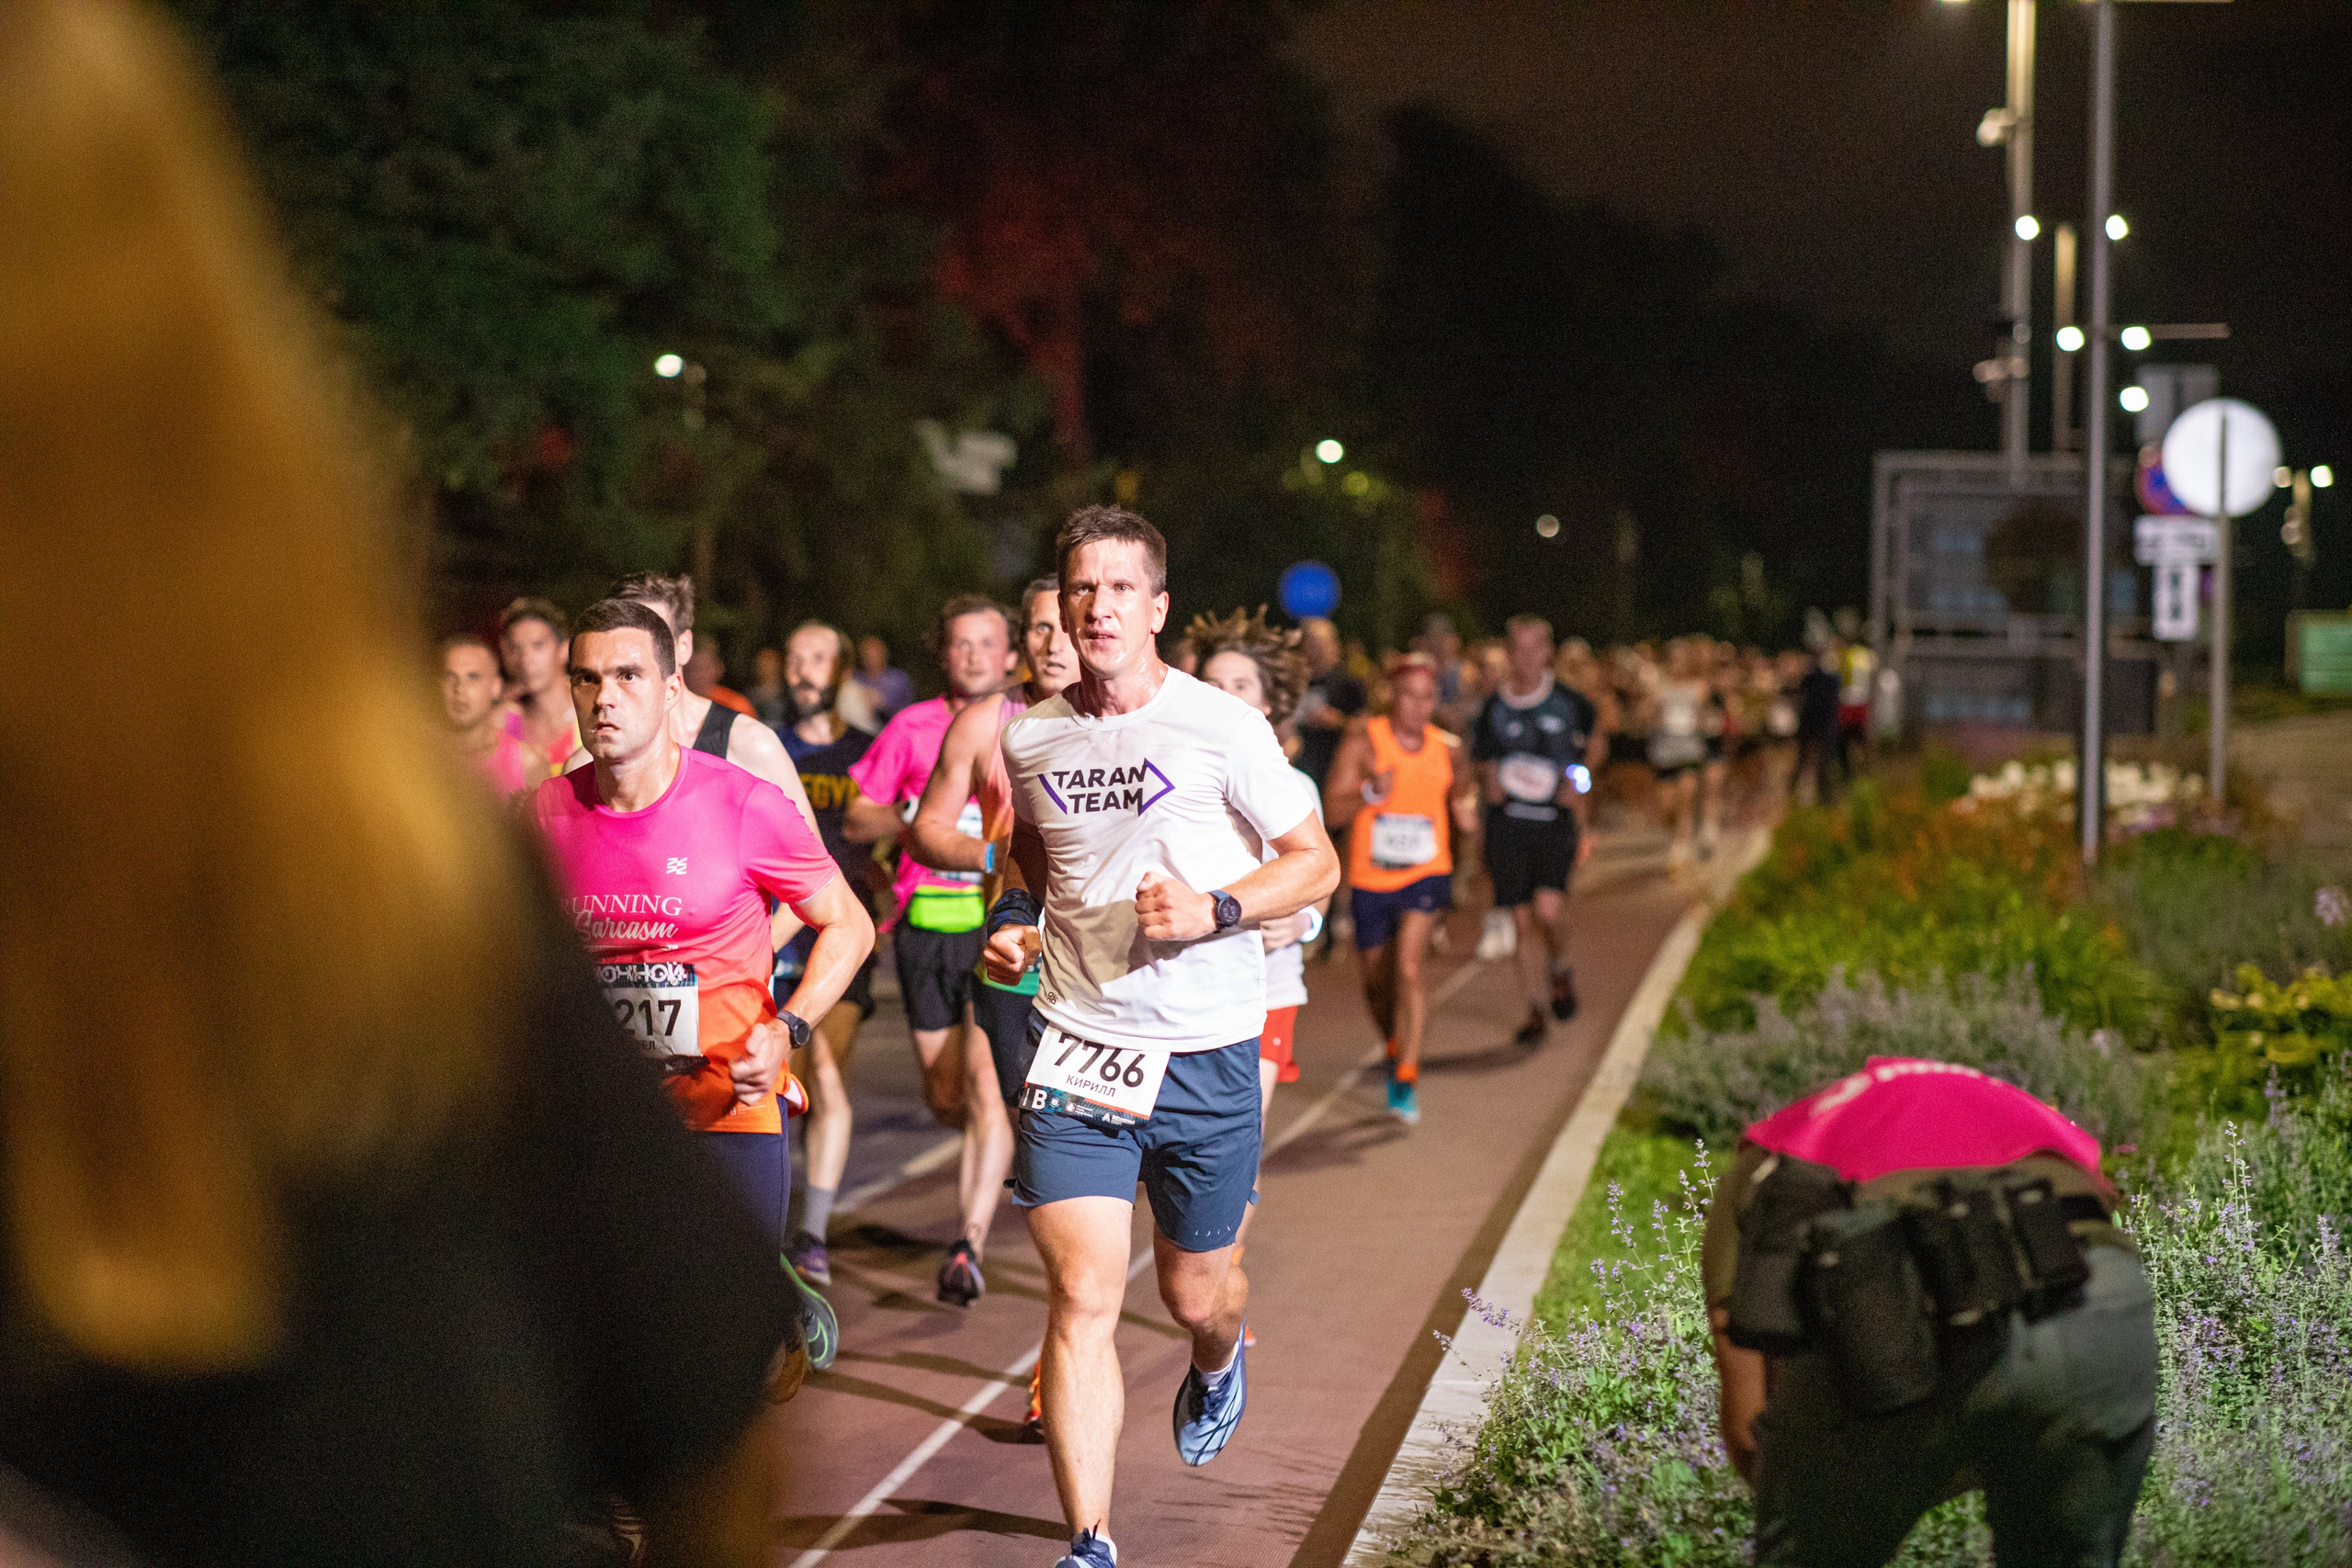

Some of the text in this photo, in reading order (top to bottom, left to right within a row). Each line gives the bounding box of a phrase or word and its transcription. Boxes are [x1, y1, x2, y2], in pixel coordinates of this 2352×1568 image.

[1052, 764, 1147, 789] TARAN
[1067, 788, 1143, 817] TEAM
[560, 894, 682, 916] RUNNING
[573, 909, 678, 941] Sarcasm
[1054, 1032, 1146, 1088] 7766
[1066, 1075, 1116, 1097] КИРИЛЛ
